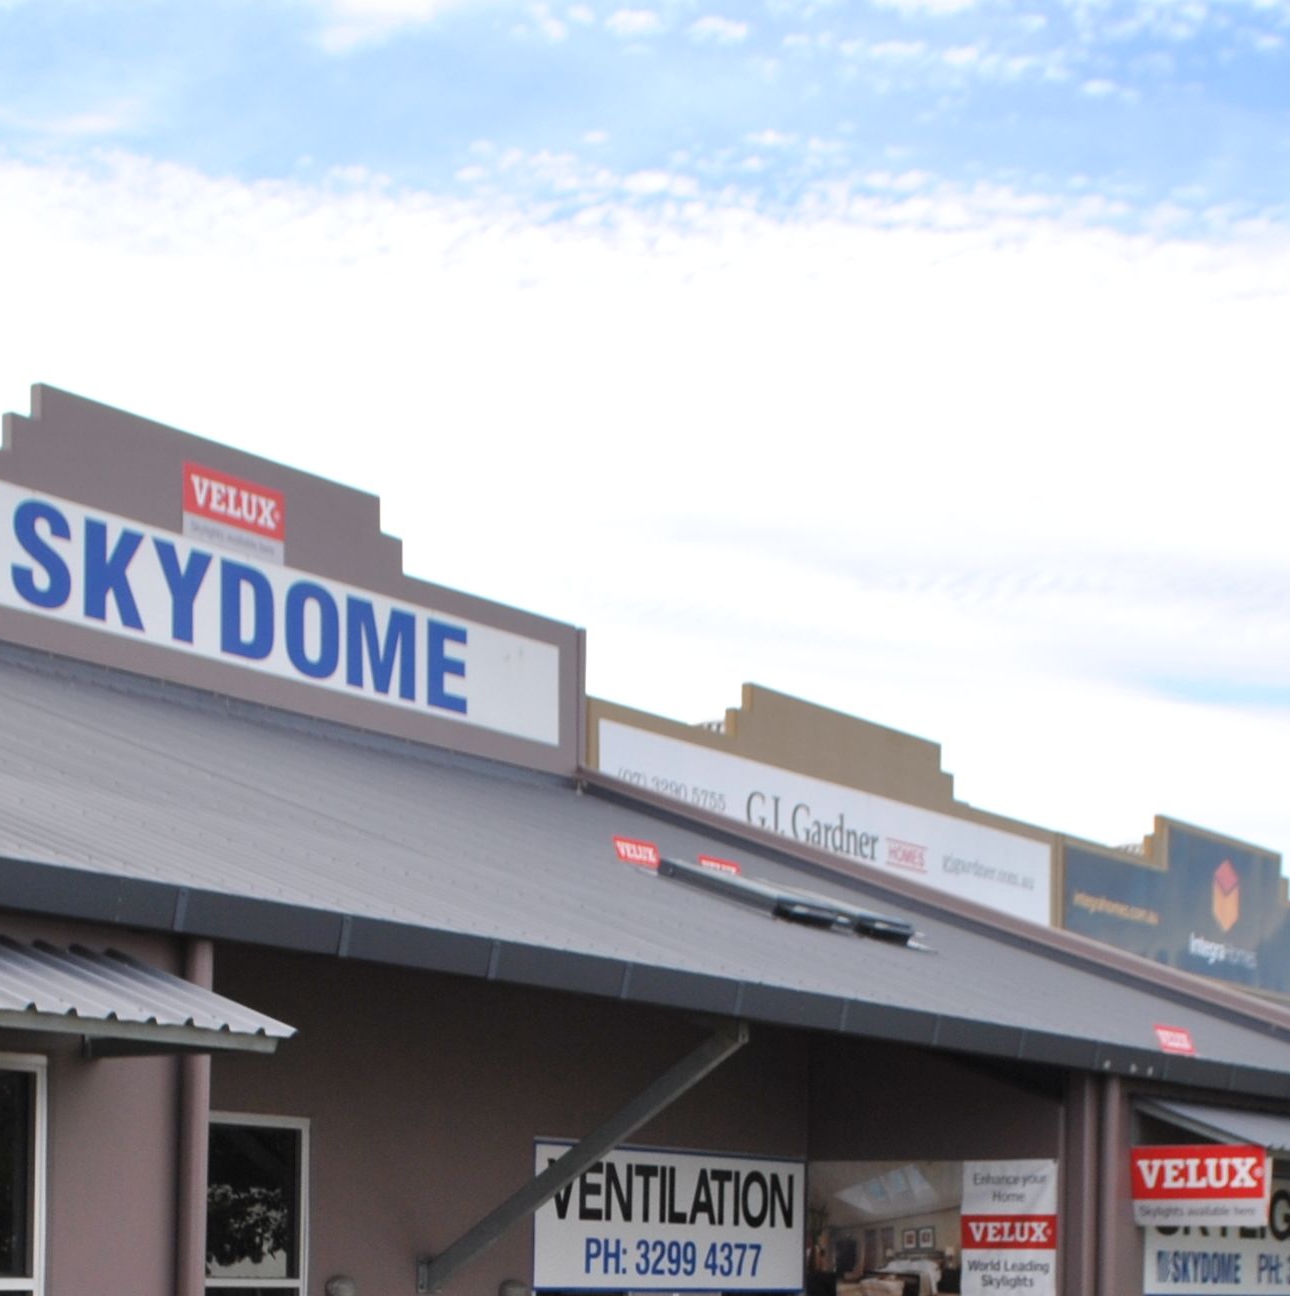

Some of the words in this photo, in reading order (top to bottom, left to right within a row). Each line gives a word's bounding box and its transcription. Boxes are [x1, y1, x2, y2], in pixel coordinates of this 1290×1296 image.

[190, 473, 277, 531] VELUX
[10, 498, 468, 715] SKYDOME
[791, 802, 880, 862] Gardner
[973, 1172, 1019, 1186] Enhance
[1019, 1173, 1047, 1187] your
[1136, 1157, 1259, 1189] VELUX
[547, 1157, 795, 1229] VENTILATION
[992, 1191, 1025, 1202] Home
[1139, 1205, 1184, 1218] Skylights
[1187, 1205, 1230, 1217] available
[968, 1221, 1048, 1243] VELUX
[584, 1237, 628, 1275] PH:
[635, 1238, 696, 1276] 3299
[703, 1241, 762, 1277] 4377
[968, 1260, 1001, 1272] World
[1004, 1260, 1050, 1275] Leading
[1172, 1250, 1242, 1285] SKYDOME
[981, 1275, 1035, 1289] Skylights
